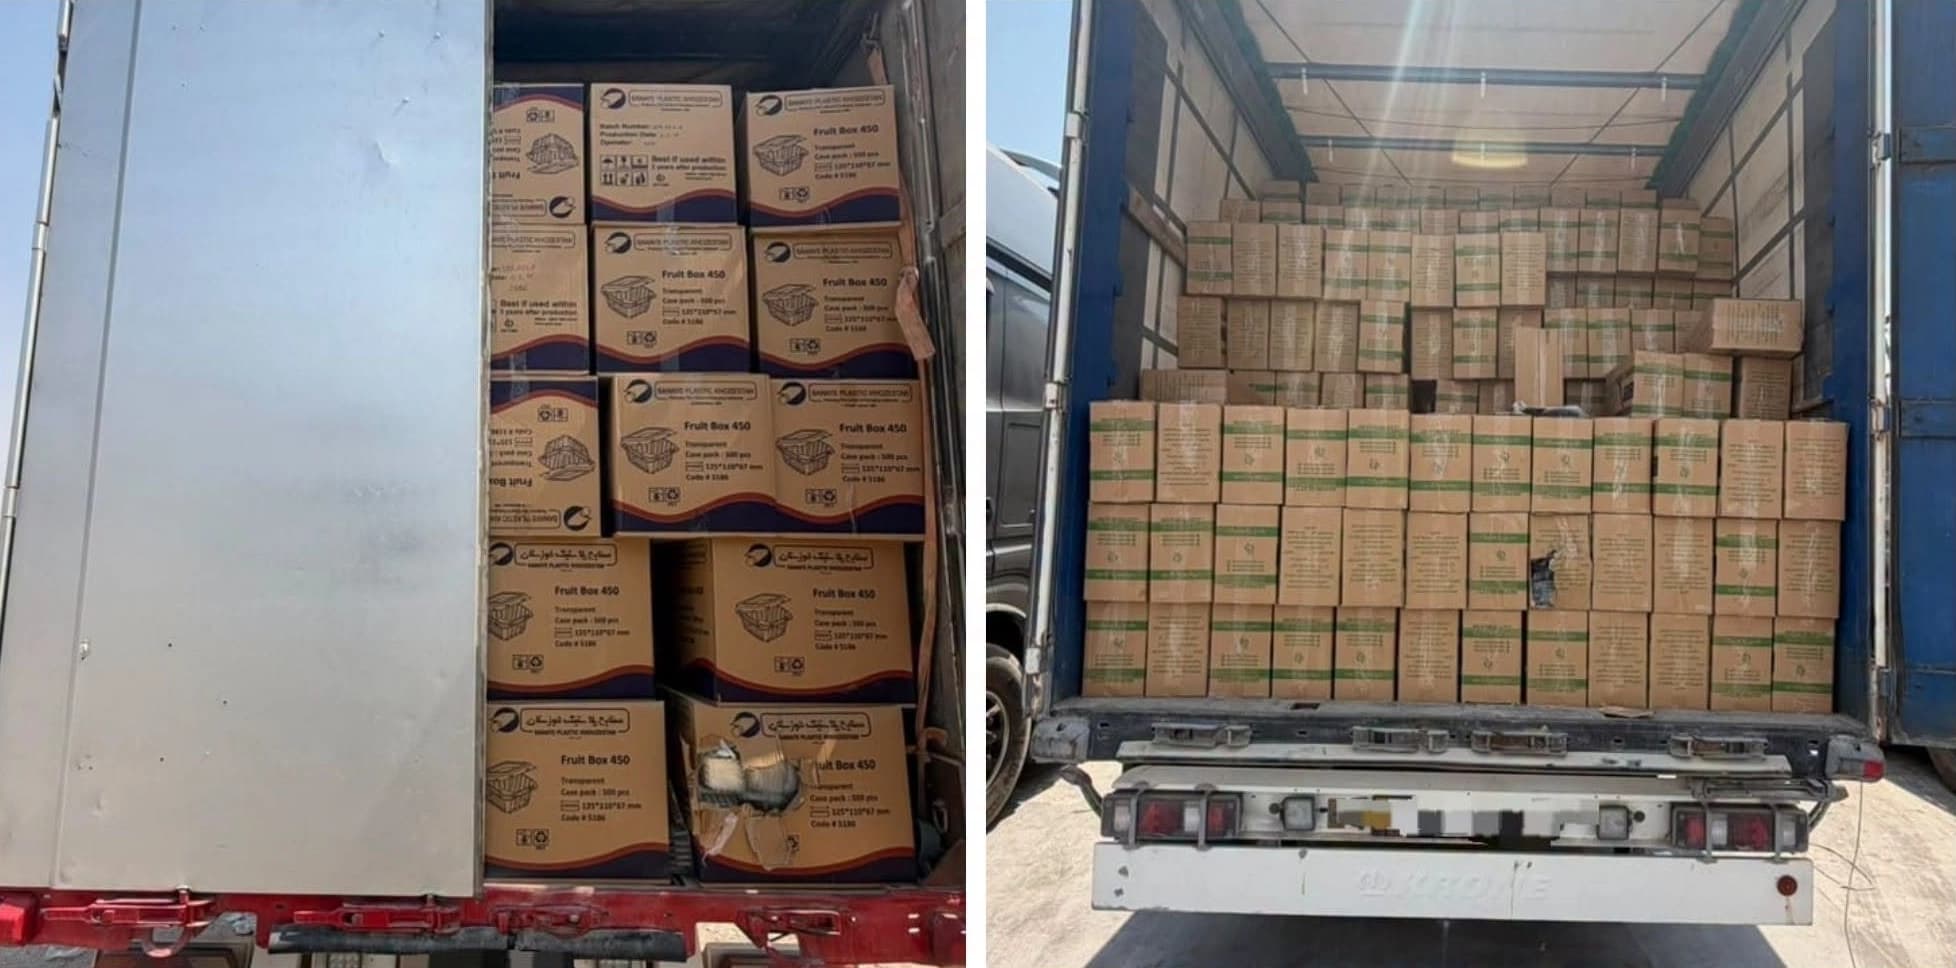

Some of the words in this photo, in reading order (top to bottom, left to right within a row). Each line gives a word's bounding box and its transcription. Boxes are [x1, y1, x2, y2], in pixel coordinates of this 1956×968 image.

[813, 128, 836, 136] Fruit
[861, 125, 879, 133] 450
[707, 270, 726, 278] 450
[822, 278, 845, 286] Fruit
[848, 278, 867, 286] Box
[869, 278, 887, 286] 450
[684, 421, 709, 430] Fruit
[711, 422, 729, 430] Box
[732, 421, 751, 430] 450
[839, 424, 864, 432] Fruit
[866, 424, 885, 432] Box
[887, 424, 907, 433] 450
[508, 479, 532, 487] Fruit
[555, 586, 578, 595] Fruit
[580, 587, 599, 595] Box
[601, 586, 620, 595] 450
[812, 588, 836, 598] Fruit
[838, 589, 855, 598] Box
[858, 590, 876, 598] 450
[561, 755, 585, 765] Fruit
[588, 755, 608, 765] Box
[610, 755, 631, 765] 450
[817, 761, 833, 771] uit
[836, 761, 856, 770] Box
[857, 760, 876, 770] 450
[561, 777, 605, 786] Transparent
